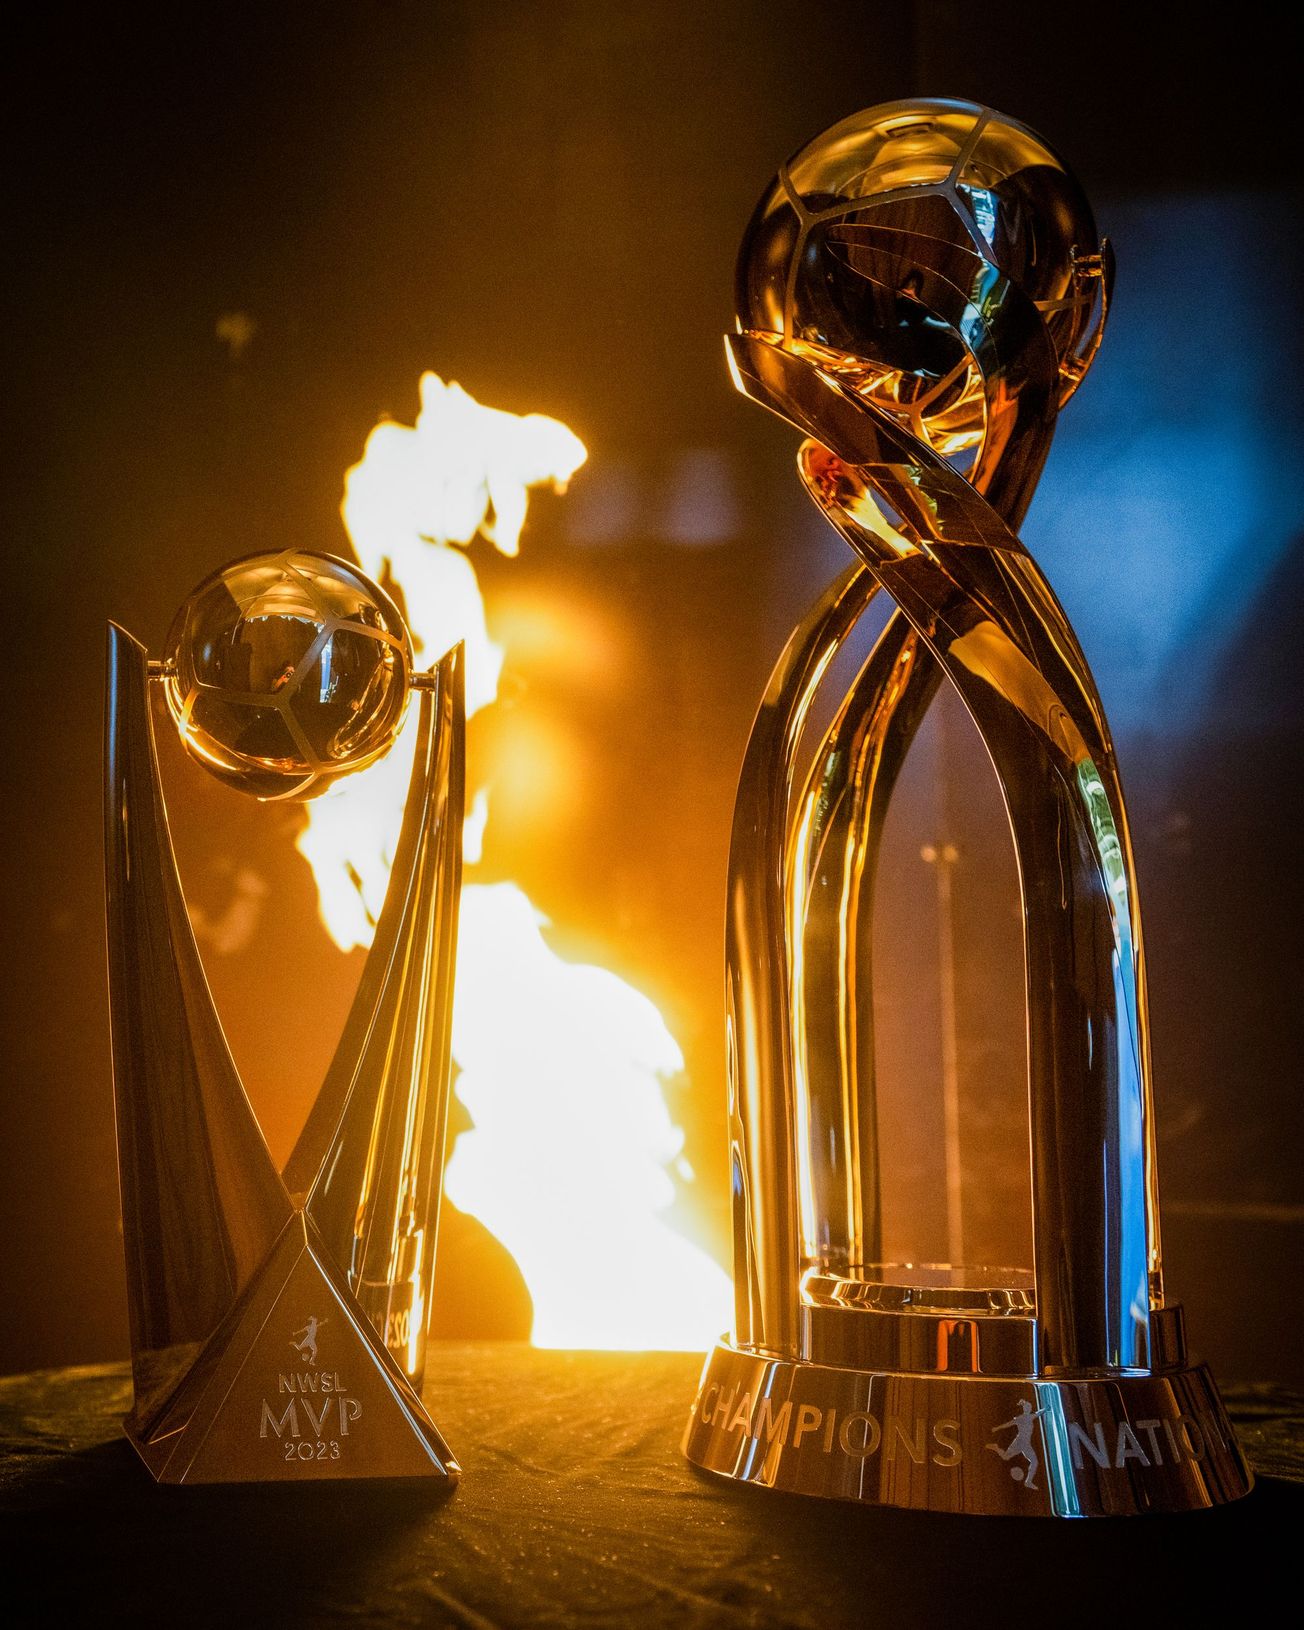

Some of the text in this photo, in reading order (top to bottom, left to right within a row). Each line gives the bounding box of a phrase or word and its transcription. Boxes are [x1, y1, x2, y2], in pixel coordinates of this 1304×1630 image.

[278, 1372, 347, 1393] NWSL
[259, 1397, 363, 1438] MVP
[701, 1382, 963, 1467] CHAMPIONS
[284, 1441, 341, 1461] 2023
